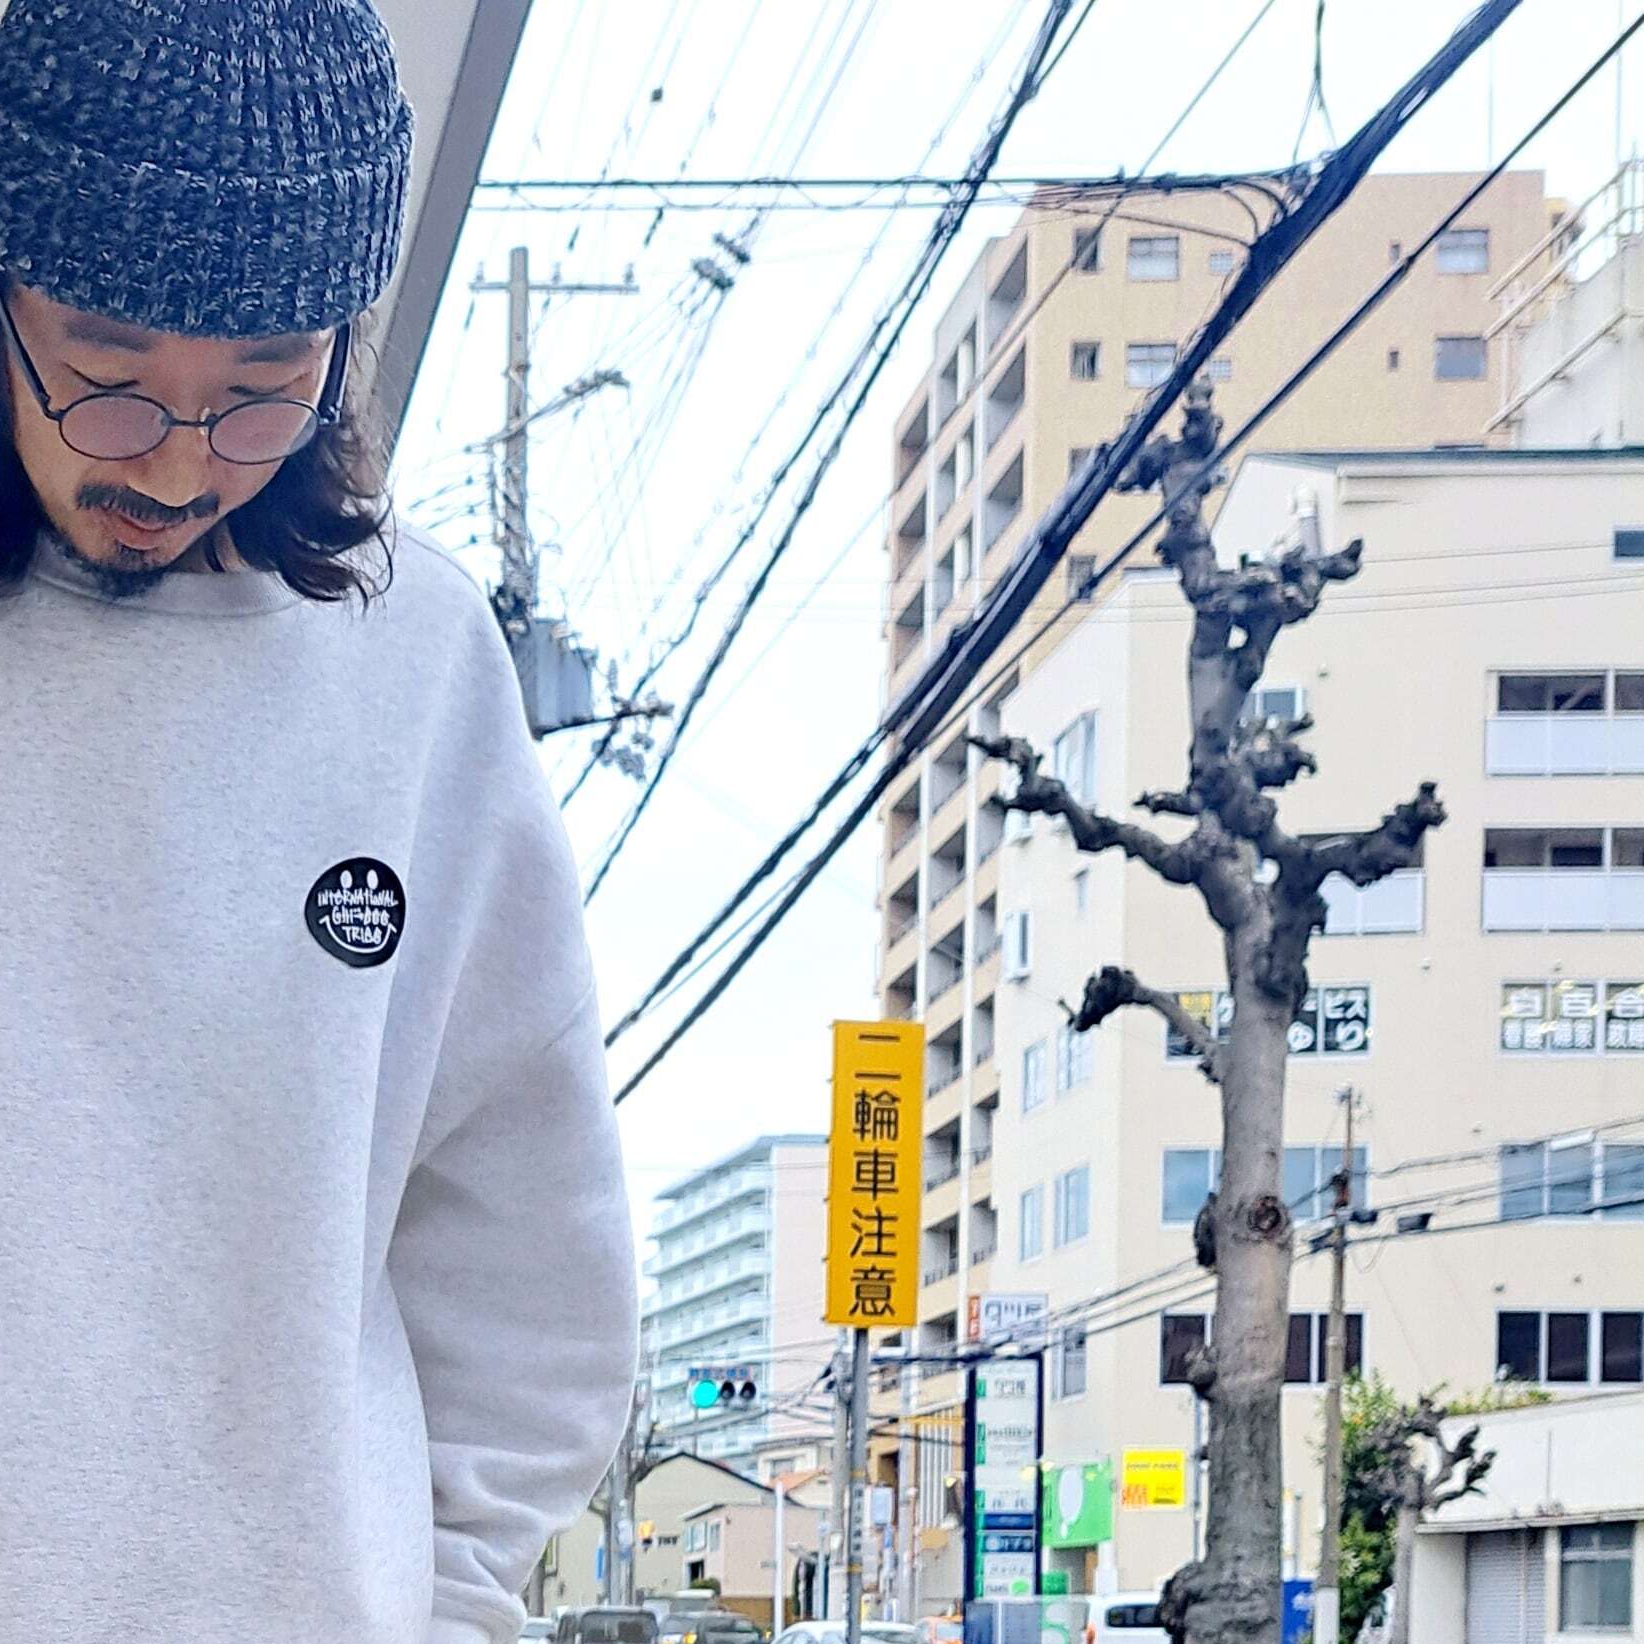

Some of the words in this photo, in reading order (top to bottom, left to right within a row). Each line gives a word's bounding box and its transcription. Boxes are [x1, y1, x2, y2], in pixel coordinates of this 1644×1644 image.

[318, 888, 399, 907] INTERNATIONAL
[849, 1033, 902, 1317] 二輪車注意
